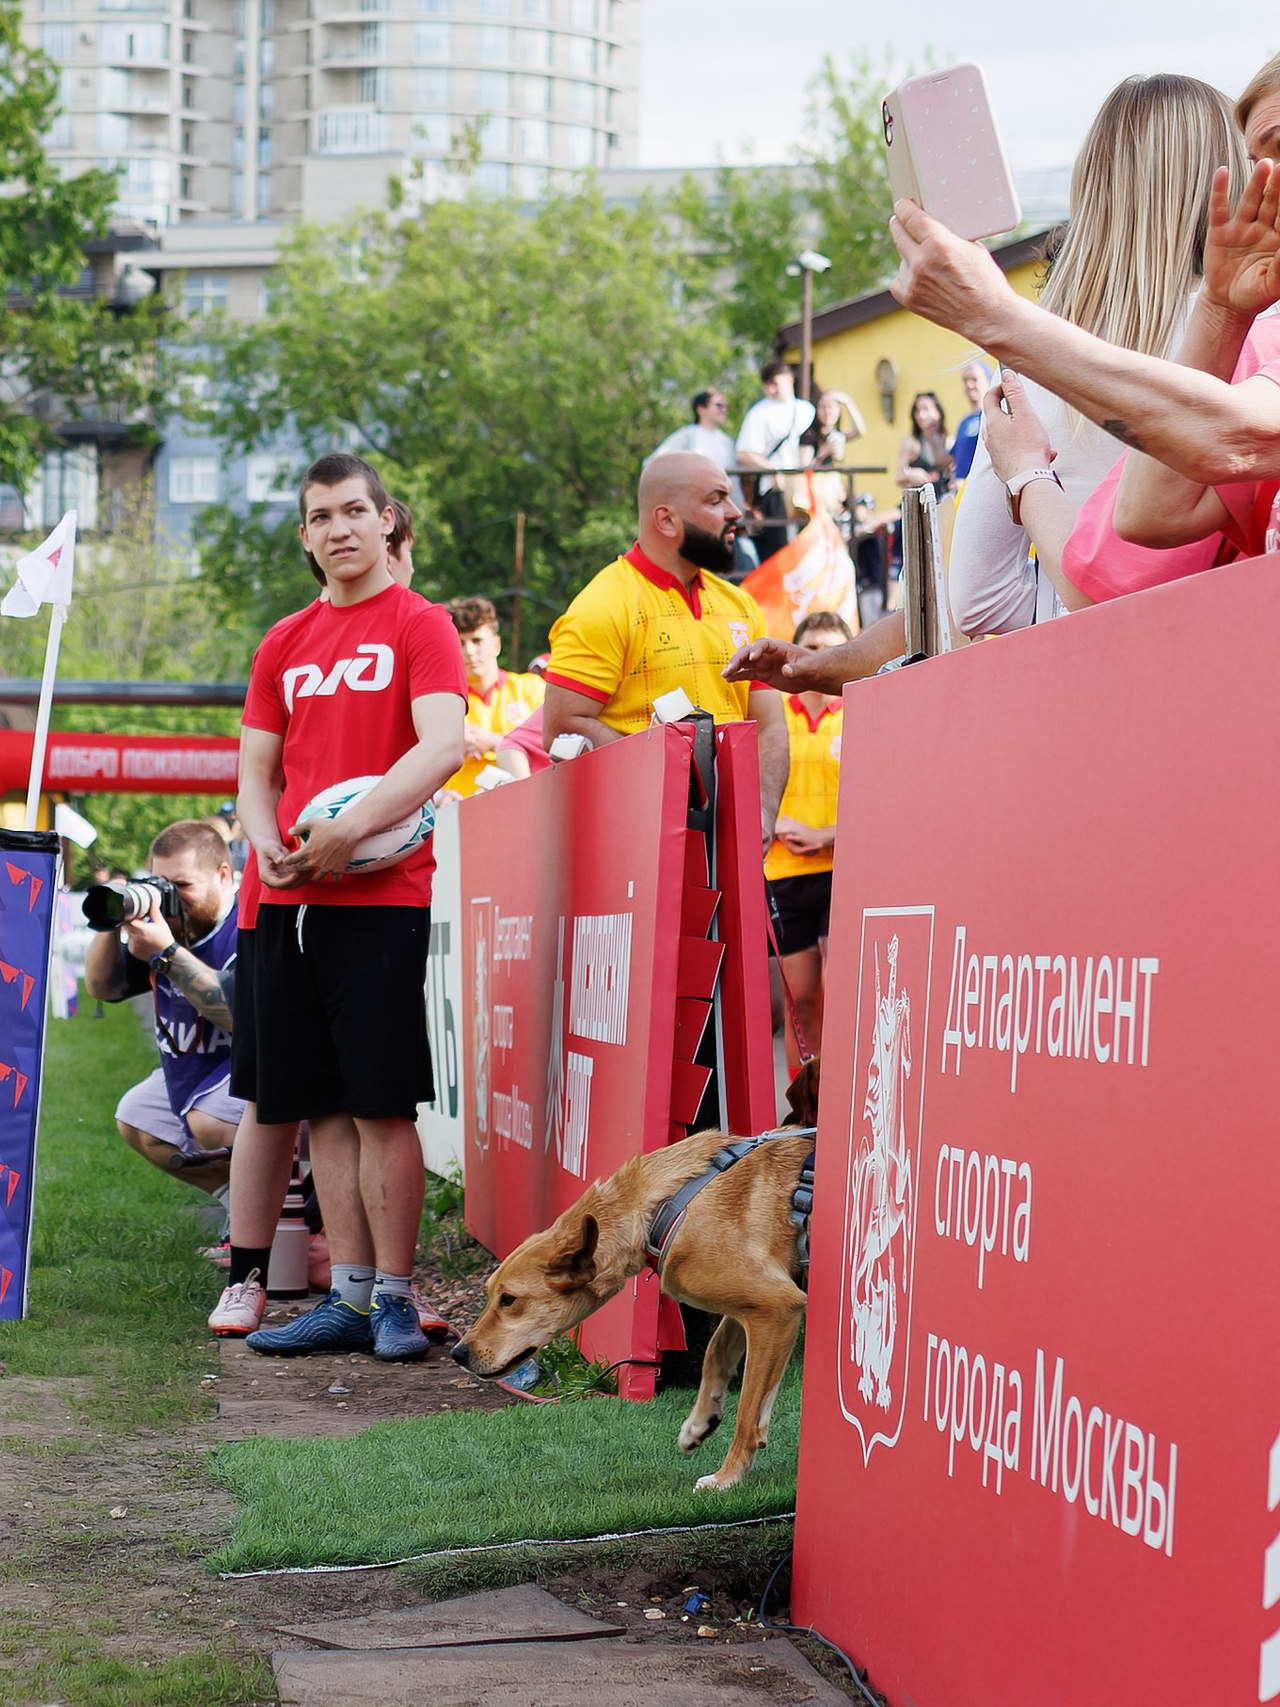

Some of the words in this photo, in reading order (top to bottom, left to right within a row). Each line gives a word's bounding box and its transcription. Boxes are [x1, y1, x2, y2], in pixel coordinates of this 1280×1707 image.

[939, 924, 1161, 1094] Департамент
[933, 1141, 1034, 1290] спорта
[922, 1331, 1023, 1496] города
[1029, 1347, 1179, 1558] Москвы
